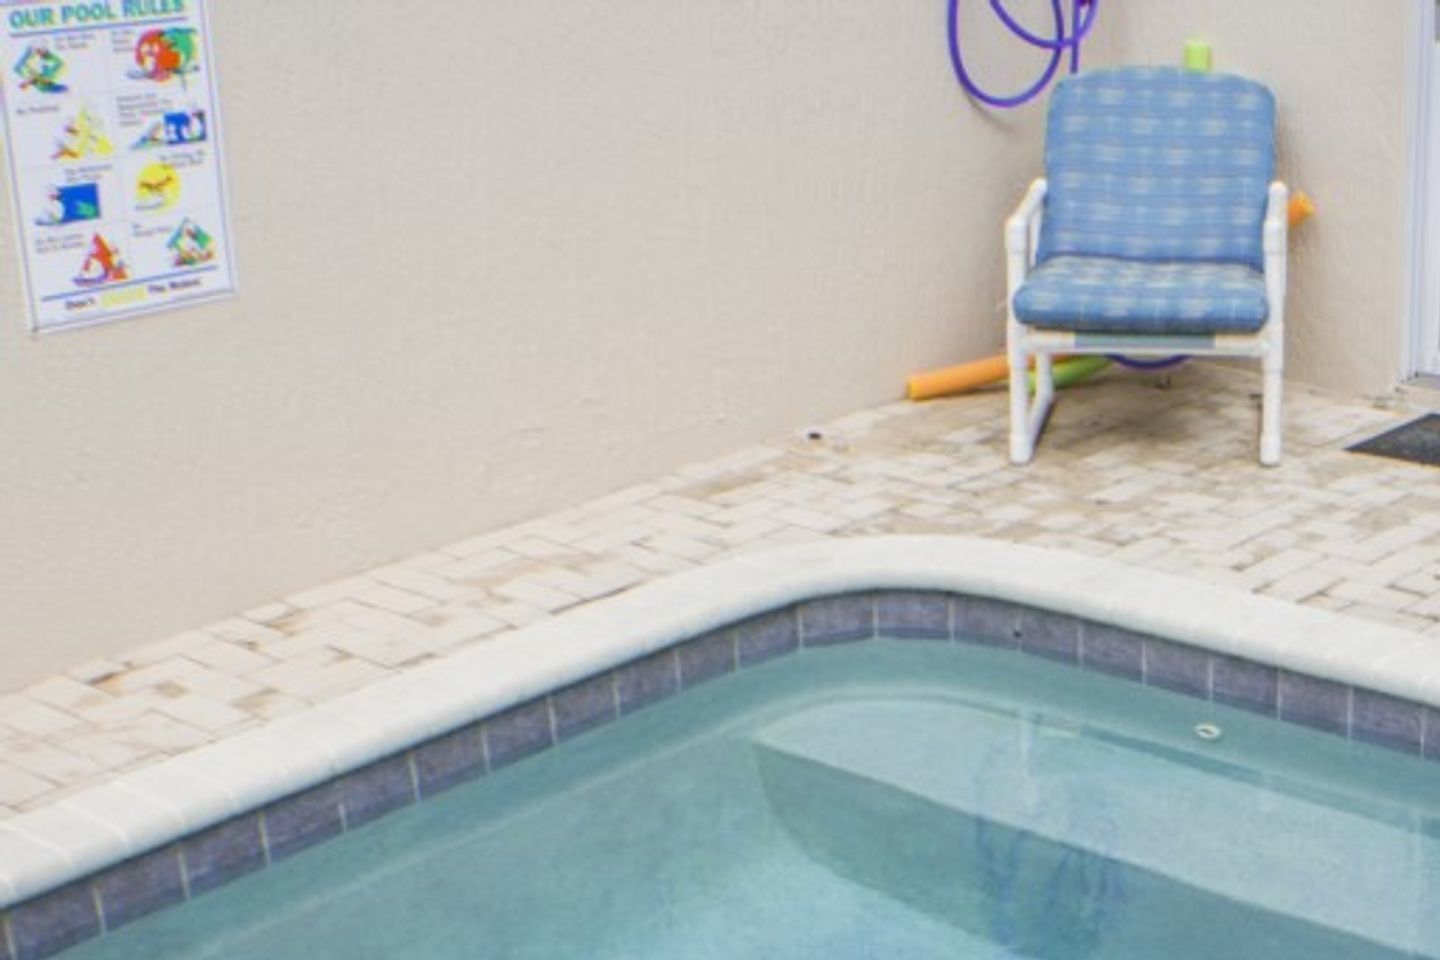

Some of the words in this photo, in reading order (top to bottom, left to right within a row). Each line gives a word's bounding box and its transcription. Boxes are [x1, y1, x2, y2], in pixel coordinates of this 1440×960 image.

[9, 7, 55, 28] OUR
[62, 3, 116, 22] POOL
[124, 0, 185, 16] RULES
